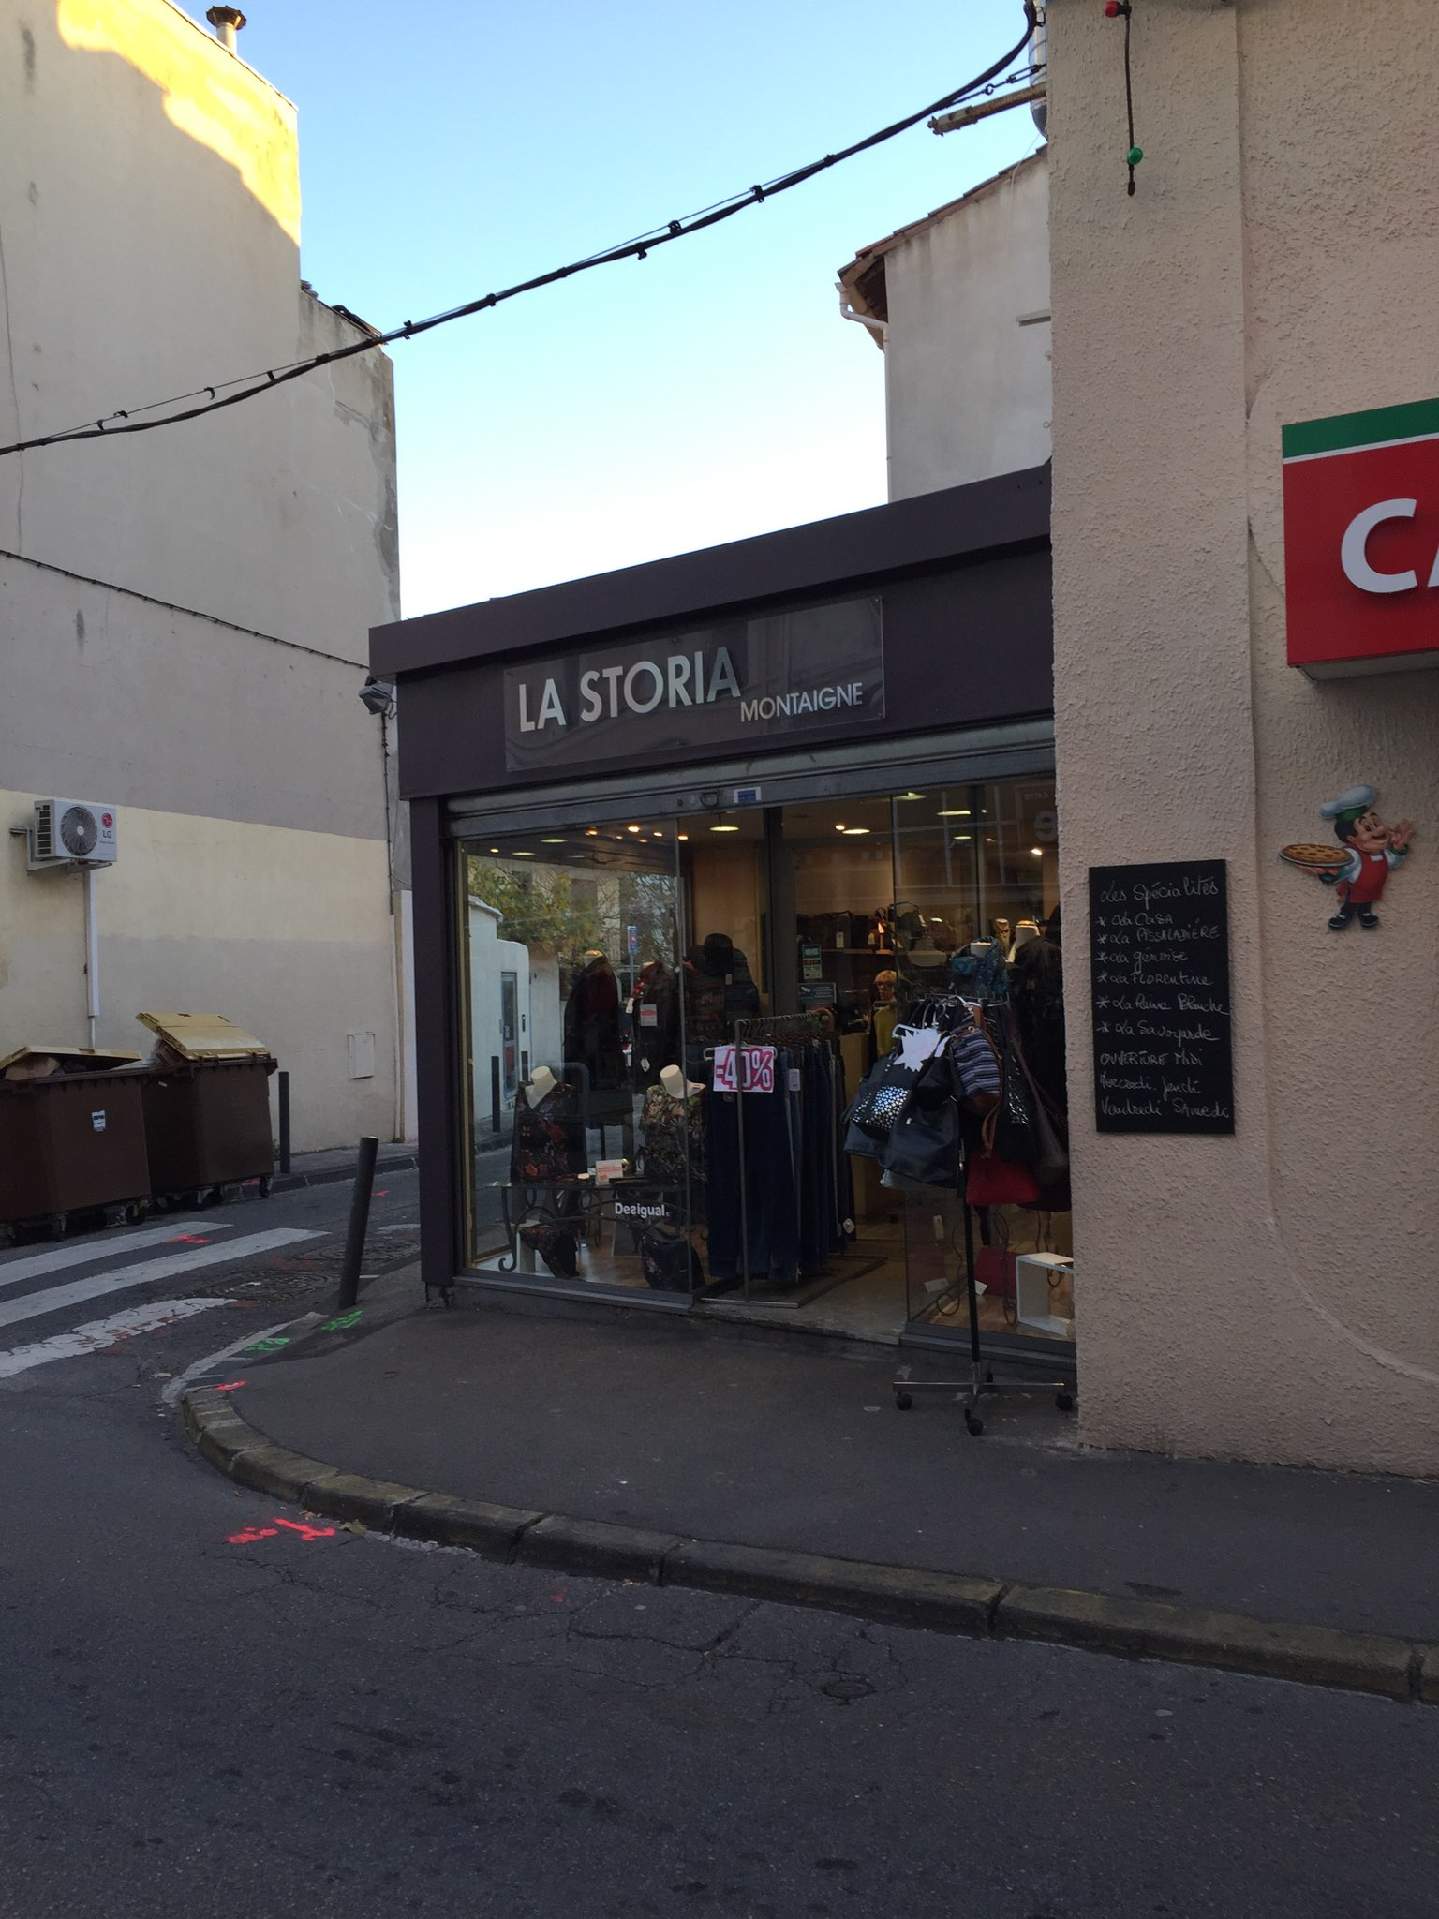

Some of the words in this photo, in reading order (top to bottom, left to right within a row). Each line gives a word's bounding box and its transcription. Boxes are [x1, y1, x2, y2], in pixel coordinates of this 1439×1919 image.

[1341, 498, 1439, 593] C
[519, 678, 566, 732] LA
[580, 646, 741, 722] STORIA
[740, 682, 864, 722] MONTAIGNE
